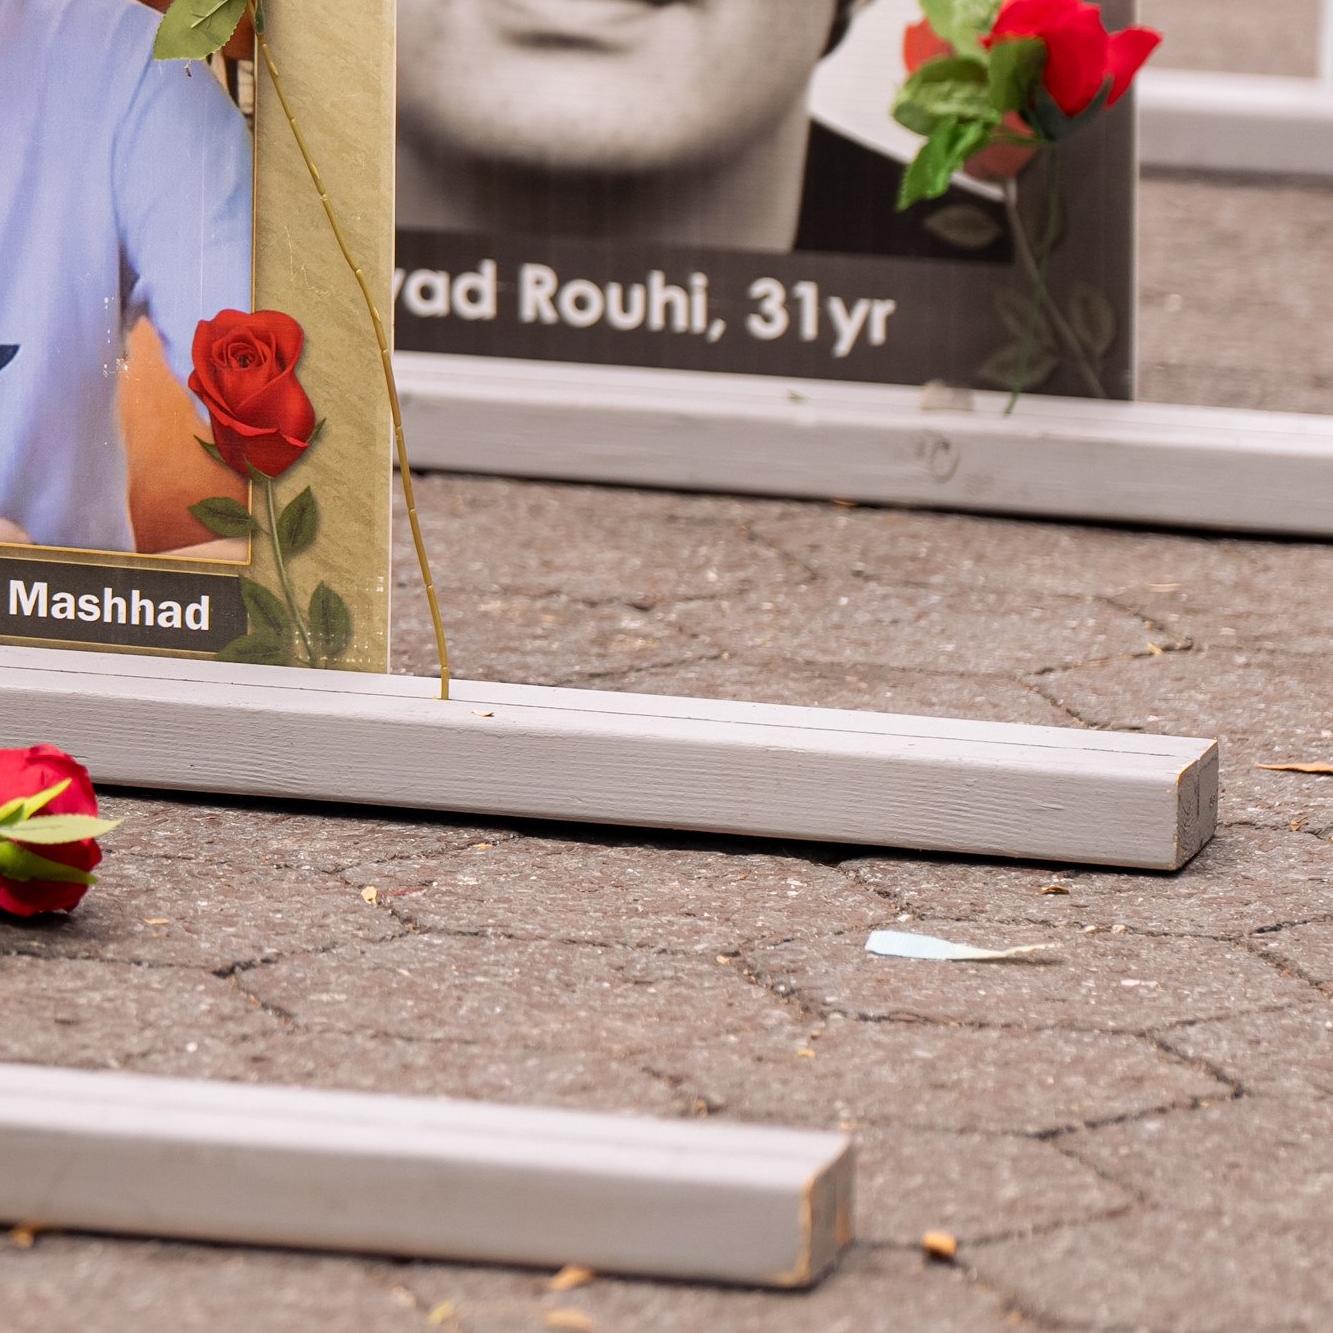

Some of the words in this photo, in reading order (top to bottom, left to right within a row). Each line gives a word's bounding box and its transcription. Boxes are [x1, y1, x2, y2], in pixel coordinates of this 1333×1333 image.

[519, 262, 727, 344] Rouhi,
[745, 276, 897, 358] 31yr
[8, 578, 210, 631] Mashhad
